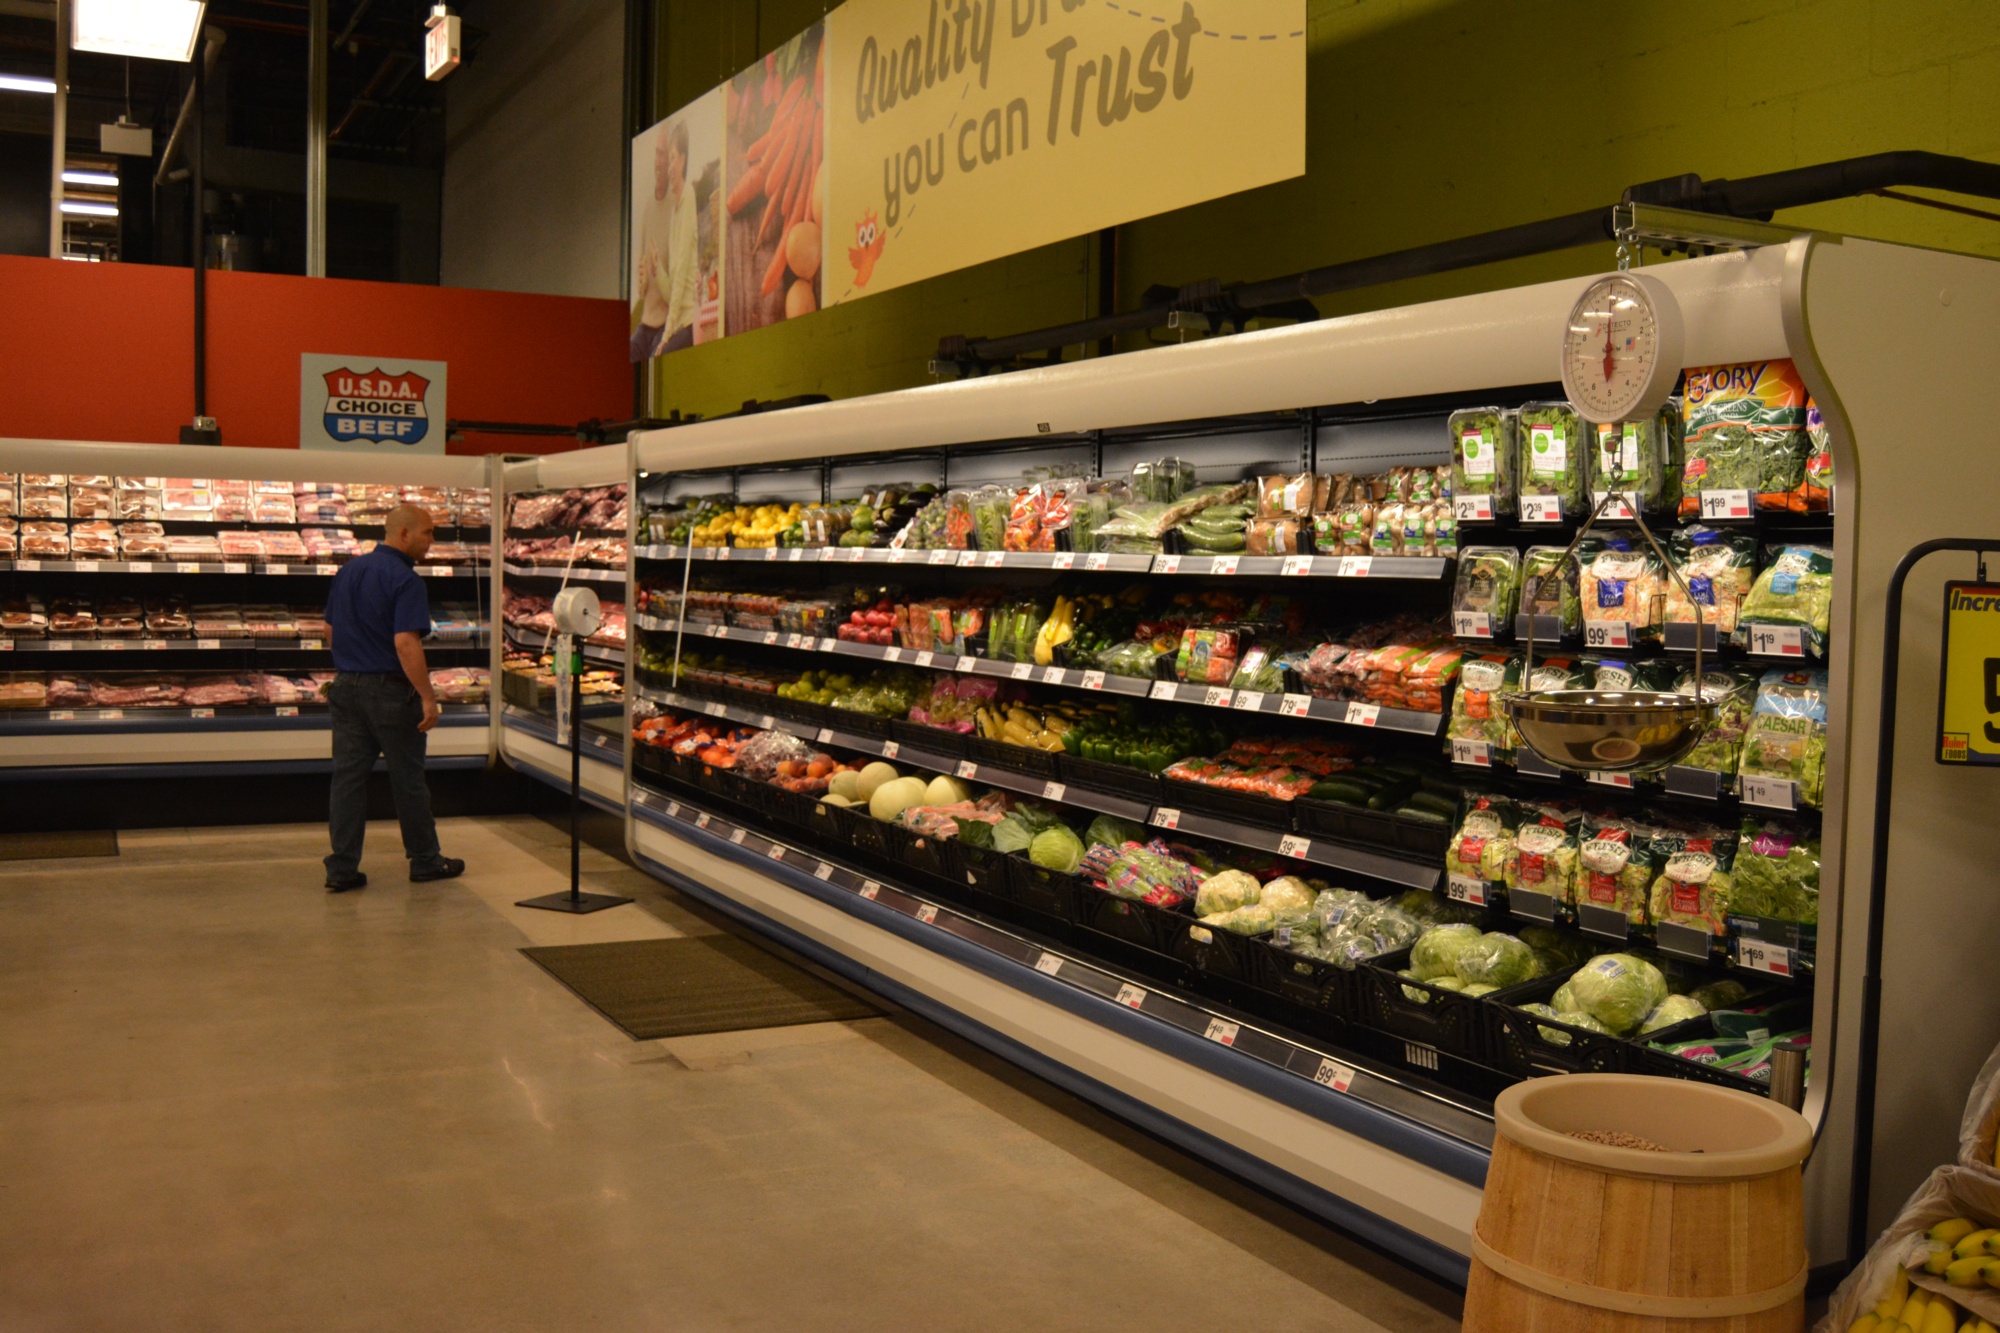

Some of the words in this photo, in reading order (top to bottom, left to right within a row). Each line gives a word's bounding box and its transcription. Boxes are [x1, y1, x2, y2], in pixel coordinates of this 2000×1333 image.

[856, 0, 996, 124] Quality
[884, 132, 945, 228] you
[958, 97, 1029, 173] can
[1045, 1, 1200, 147] Trust
[1602, 319, 1632, 330] DTECTO
[339, 377, 418, 399] U.S.D.A.
[1687, 363, 1769, 404] GLORY
[336, 399, 417, 416] CHOICE
[337, 418, 414, 436] BEEF
[1757, 714, 1807, 735] CAESAR
[1316, 1064, 1338, 1085] 99¢
